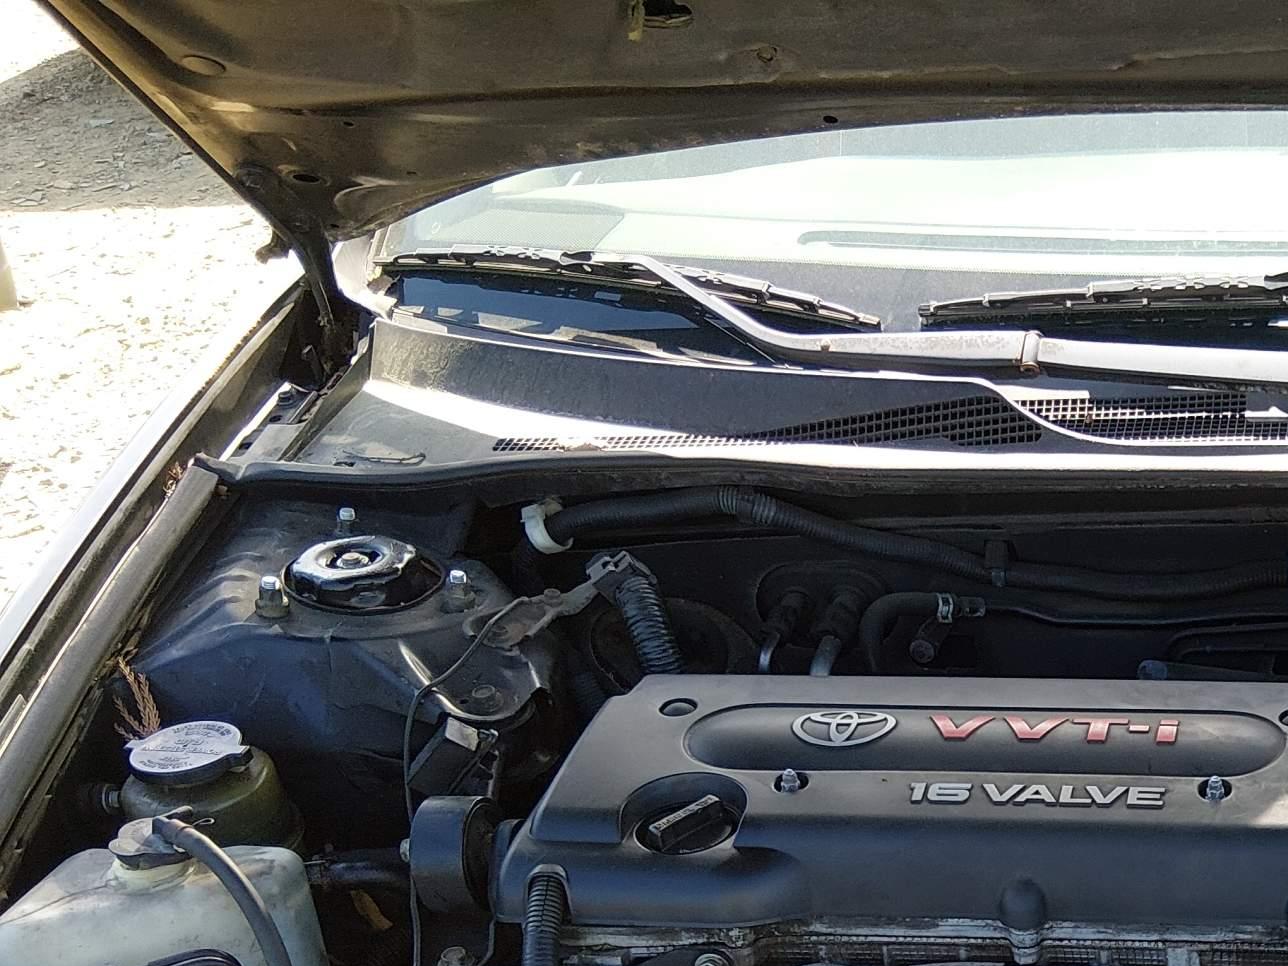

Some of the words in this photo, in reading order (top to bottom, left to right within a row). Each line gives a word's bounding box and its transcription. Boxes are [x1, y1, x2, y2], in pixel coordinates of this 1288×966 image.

[930, 715, 1180, 744] VVT-i
[909, 782, 973, 804] 16
[982, 783, 1167, 808] VALVE
